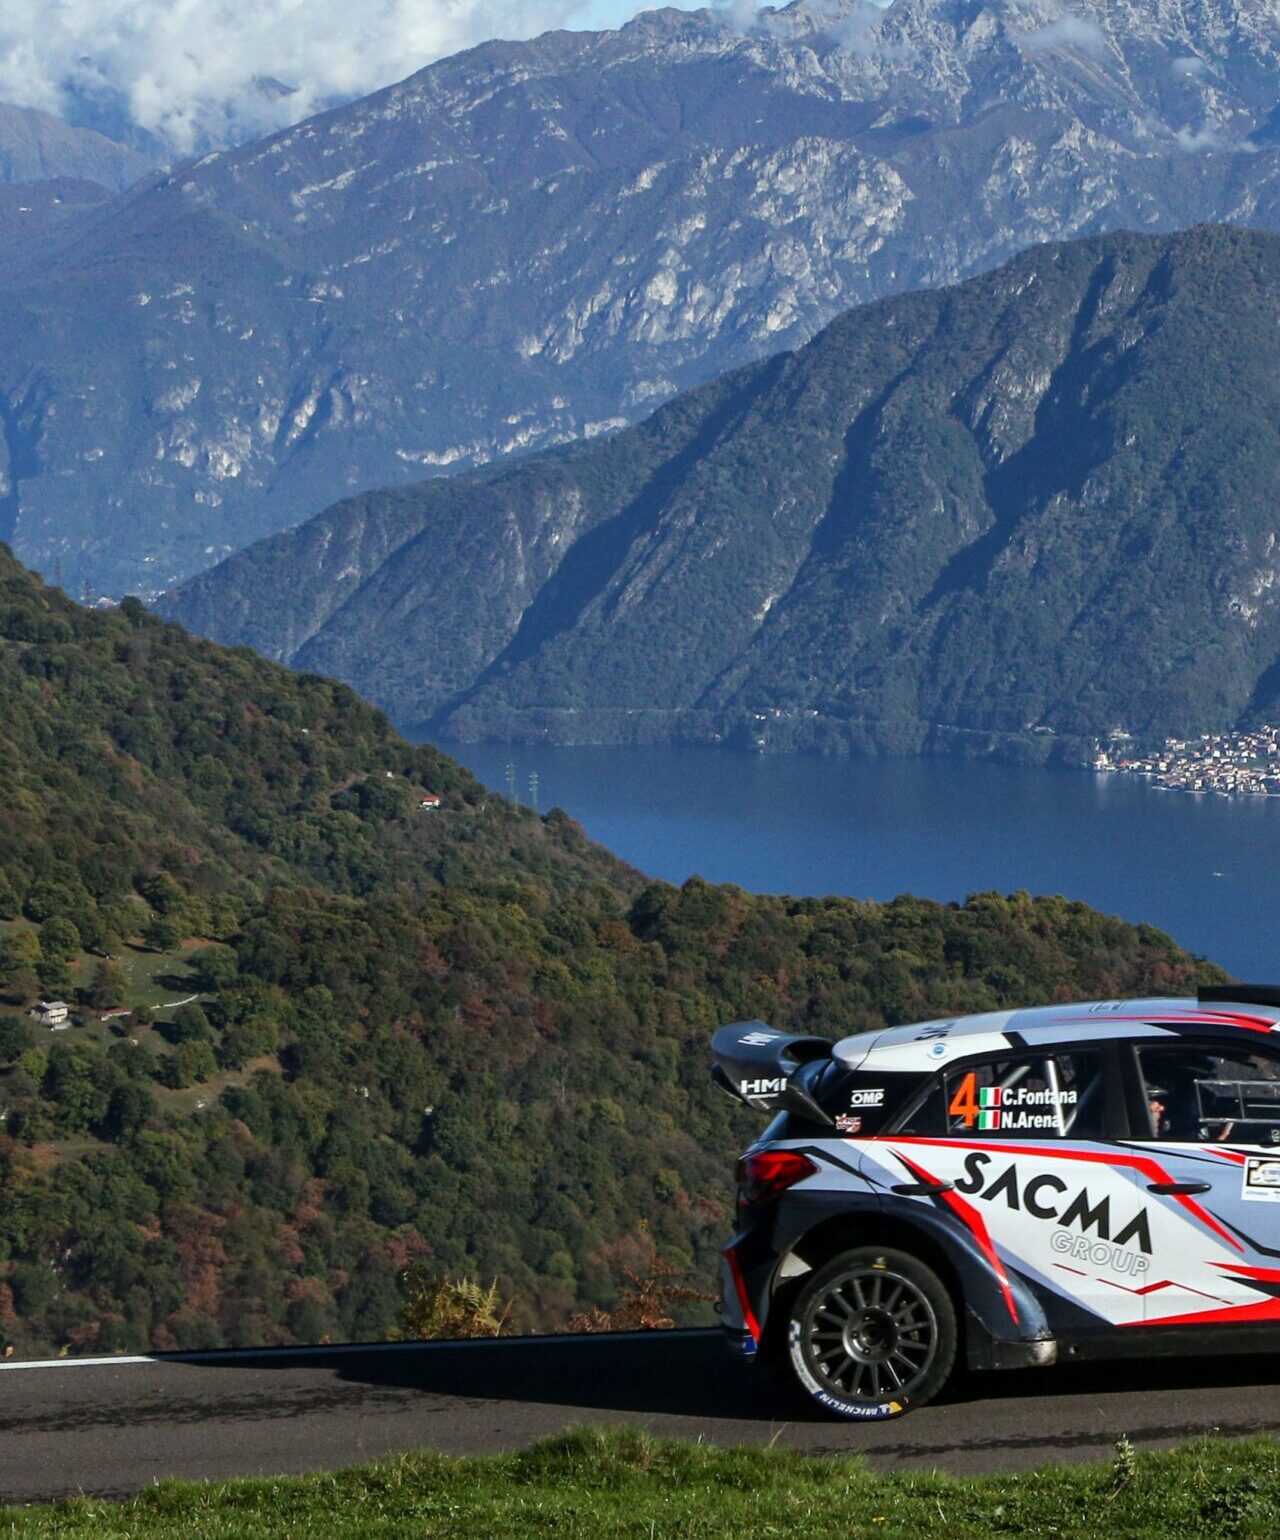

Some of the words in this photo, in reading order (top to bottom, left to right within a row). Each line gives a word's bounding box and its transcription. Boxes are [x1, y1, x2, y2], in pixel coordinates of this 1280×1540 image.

[740, 1077, 788, 1094] HMI
[851, 1092, 884, 1104] OMP
[949, 1072, 980, 1127] 4
[1001, 1087, 1077, 1105] C.Fontana
[1001, 1111, 1061, 1129] N.Arena
[954, 1152, 1153, 1255] SACMA
[1051, 1230, 1150, 1277] GROUP
[819, 1393, 879, 1416] MICHELIN
